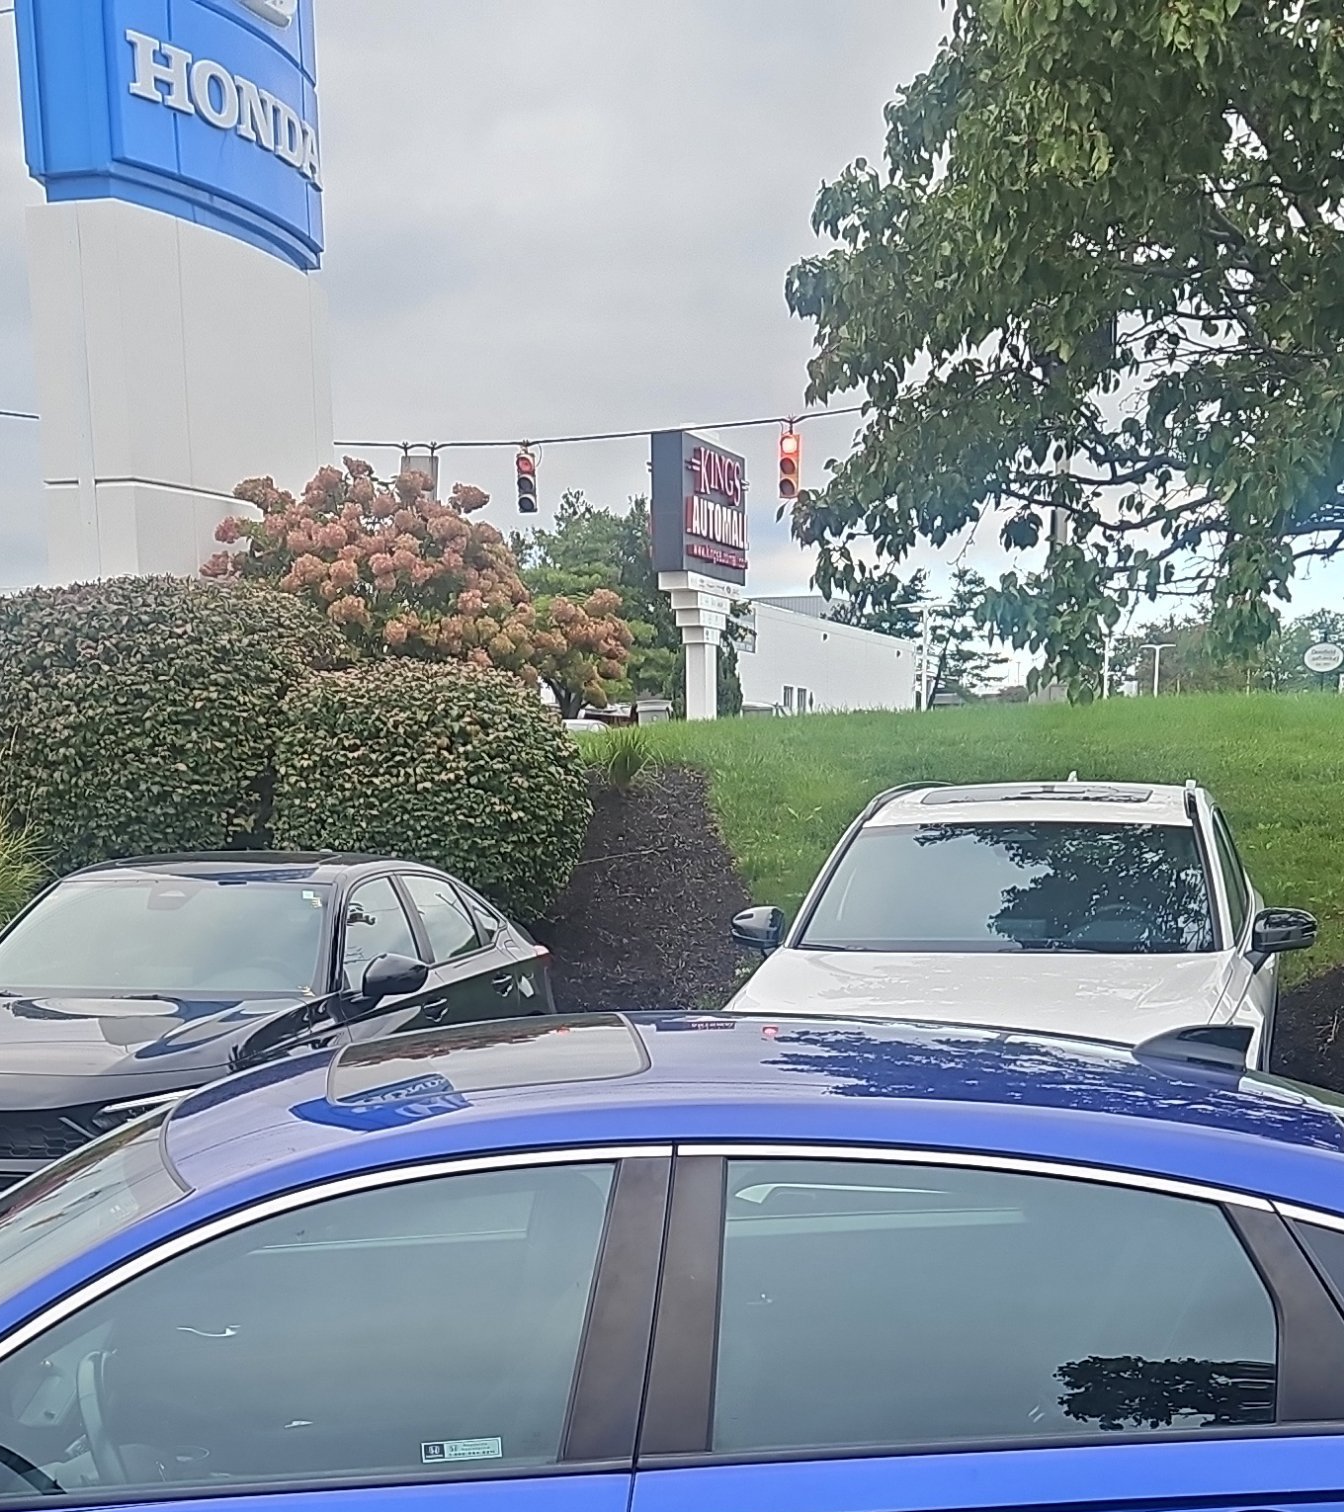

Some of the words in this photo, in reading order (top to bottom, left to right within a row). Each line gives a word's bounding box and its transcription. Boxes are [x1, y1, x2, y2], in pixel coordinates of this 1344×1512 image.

[125, 28, 323, 192] HONDA
[699, 446, 741, 506] KINGS
[691, 496, 749, 549] AUTOMALL
